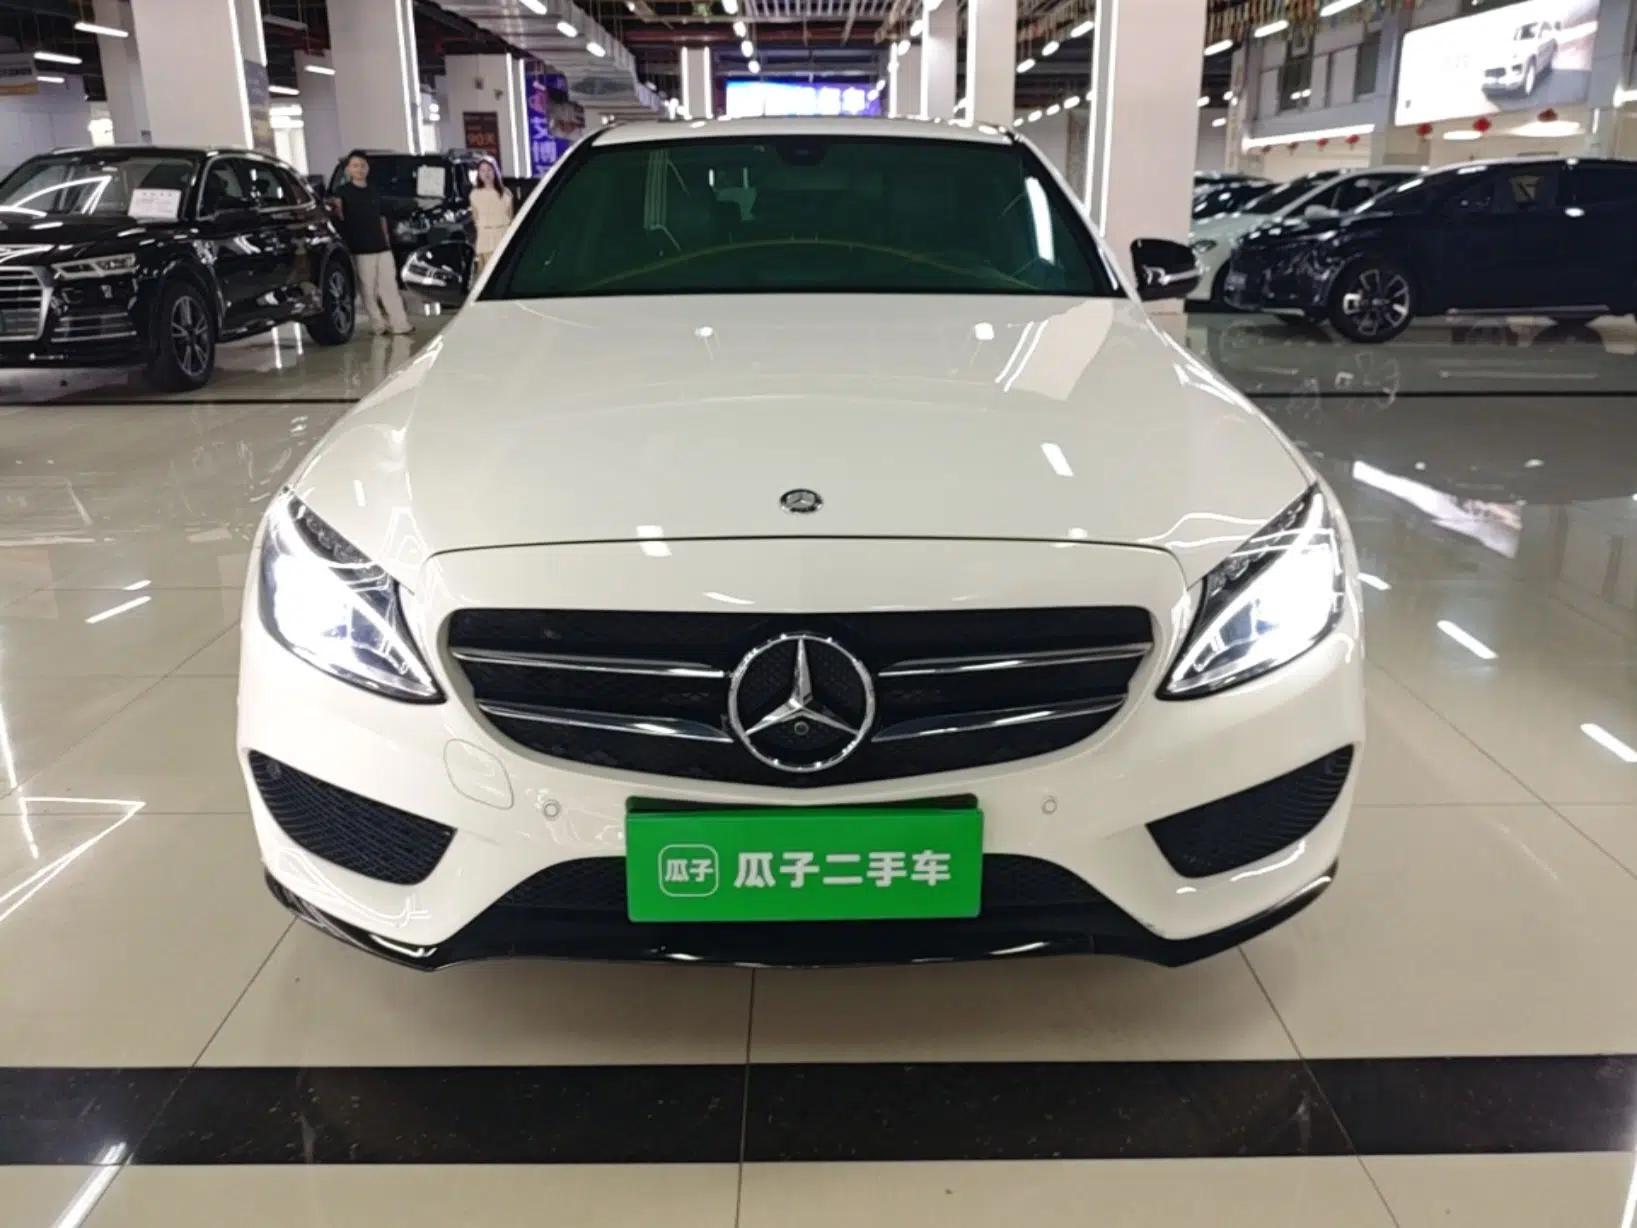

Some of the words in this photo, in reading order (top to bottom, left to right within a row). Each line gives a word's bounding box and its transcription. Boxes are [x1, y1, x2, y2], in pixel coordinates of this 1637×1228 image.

[665, 859, 713, 881] 瓜子
[735, 850, 950, 887] 瓜子二手车
